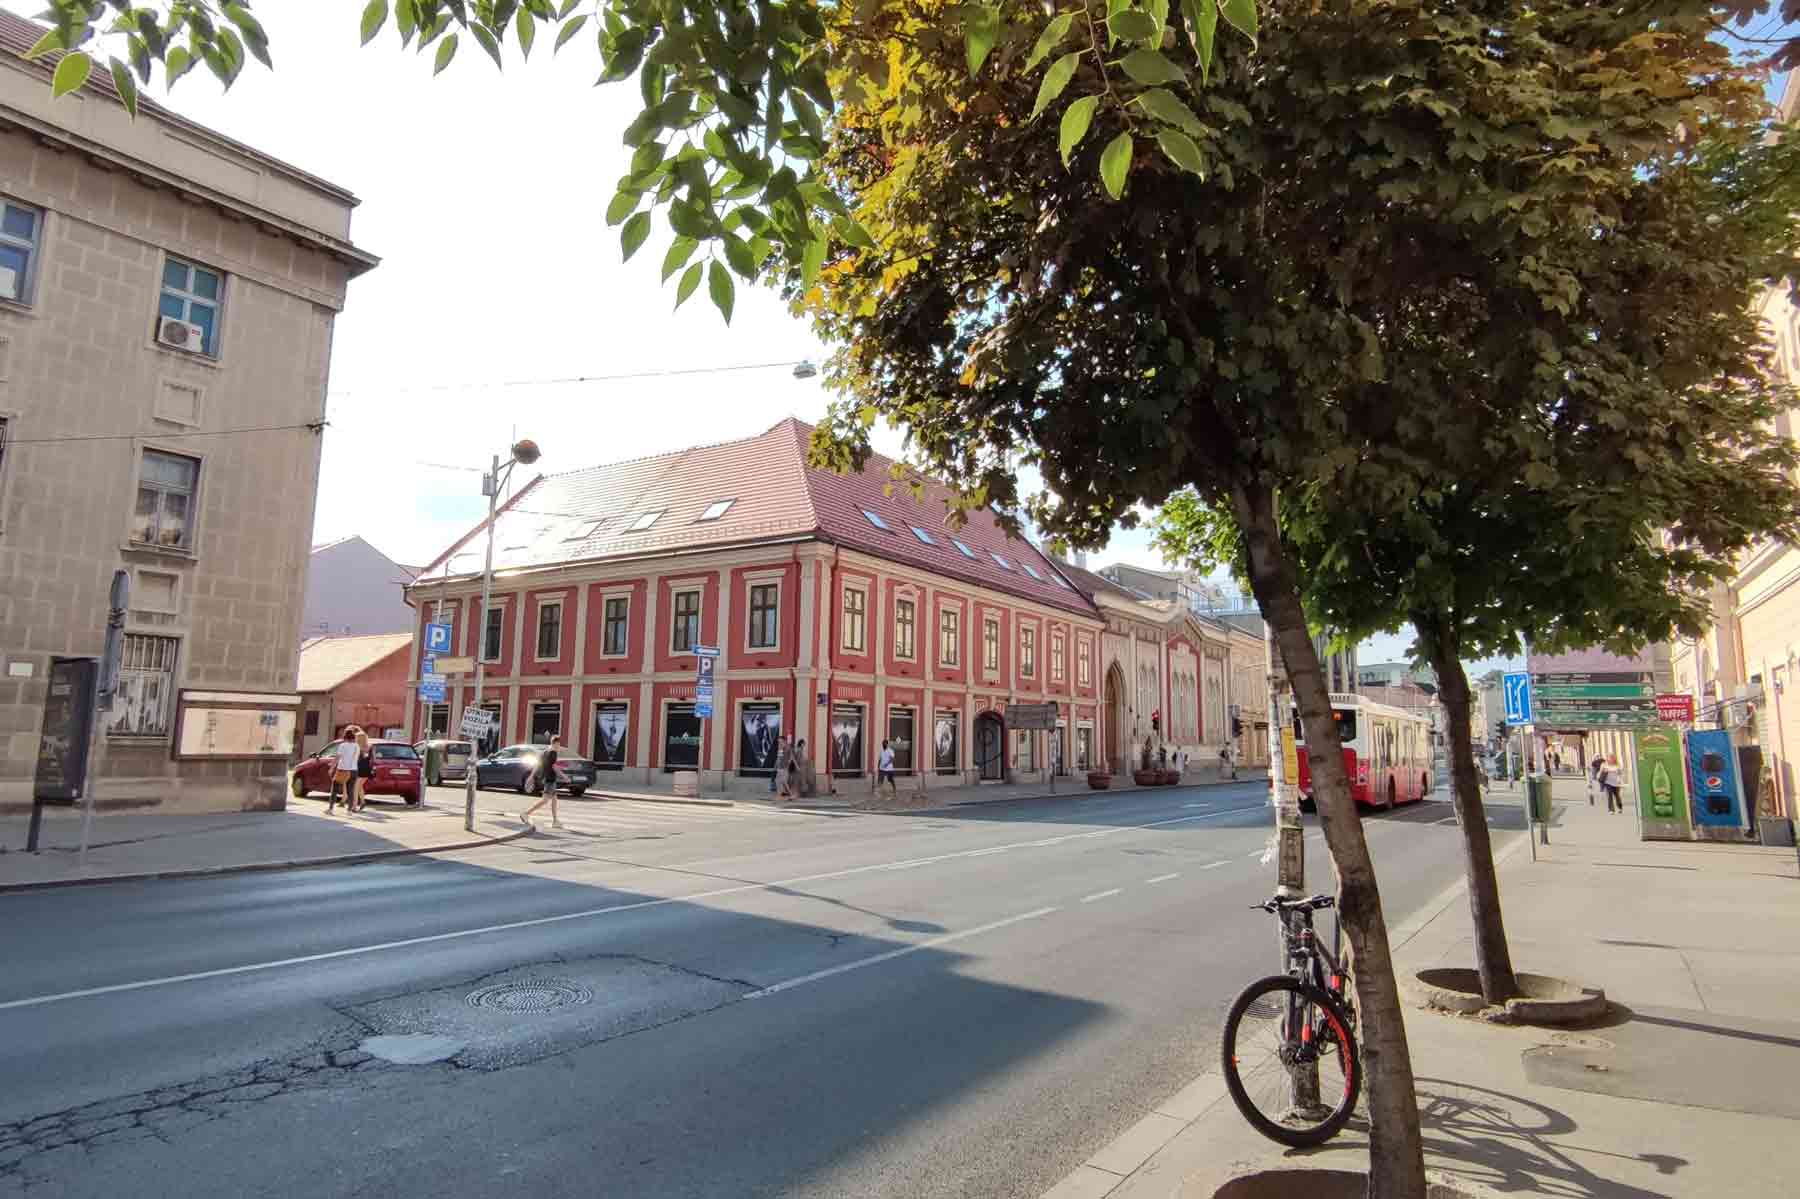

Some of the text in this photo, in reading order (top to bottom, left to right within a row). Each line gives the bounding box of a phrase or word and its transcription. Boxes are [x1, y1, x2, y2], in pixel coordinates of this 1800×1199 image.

[431, 626, 446, 648] P
[702, 658, 712, 674] P
[466, 707, 490, 717] OTKUP
